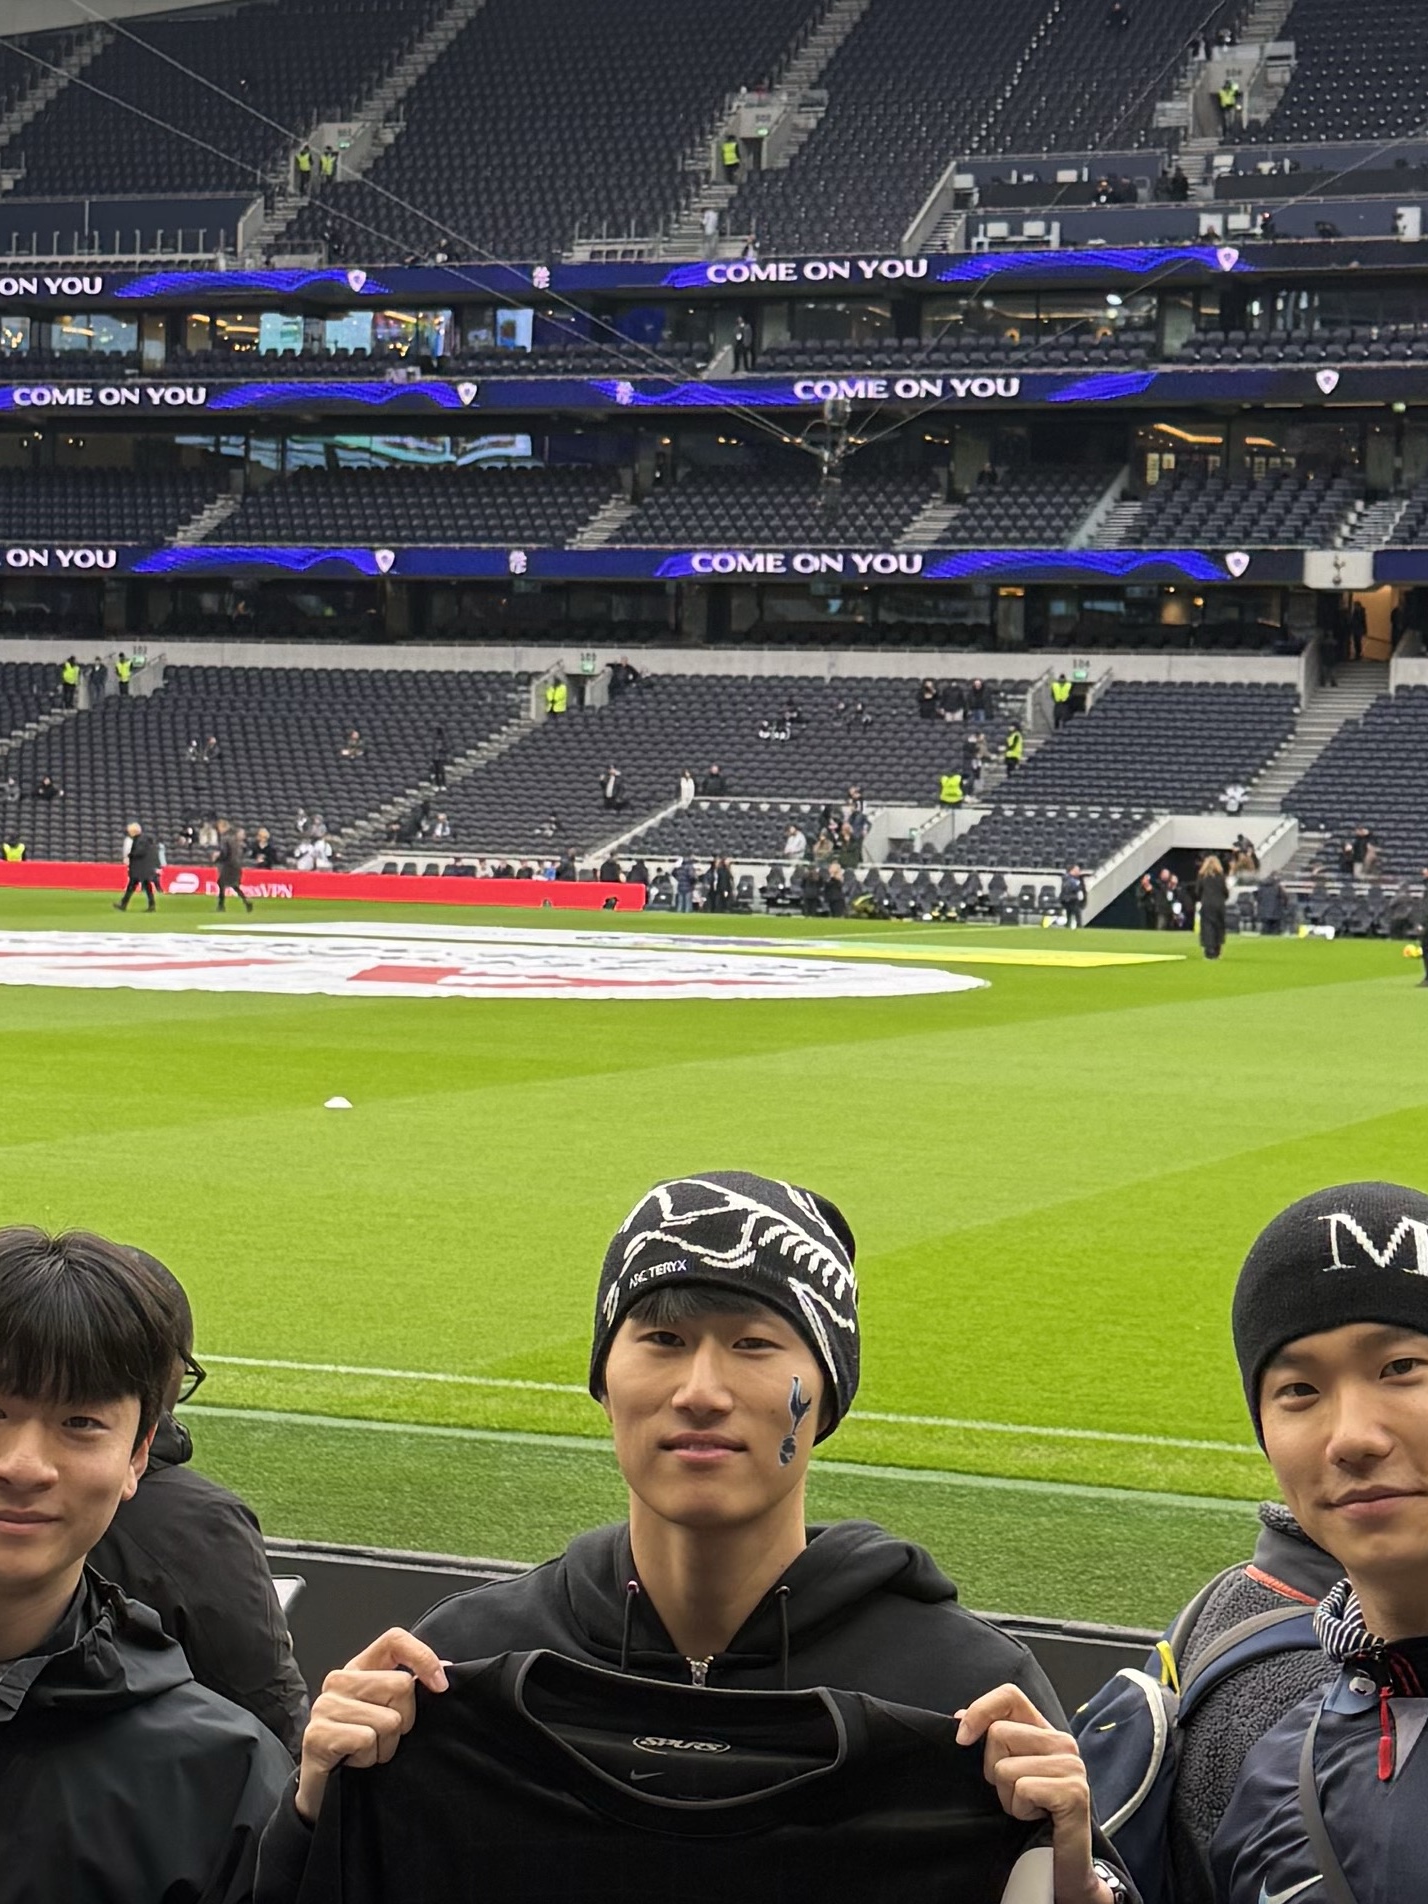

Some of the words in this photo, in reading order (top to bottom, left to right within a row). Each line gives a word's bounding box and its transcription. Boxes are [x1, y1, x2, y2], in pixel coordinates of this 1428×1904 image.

[707, 263, 799, 284] COME
[803, 261, 851, 282] ON
[858, 258, 929, 280] YOU
[44, 276, 103, 296] YOU
[13, 387, 95, 407] COME
[99, 387, 141, 407] ON
[146, 386, 207, 406] YOU
[794, 380, 890, 400] COME
[894, 379, 944, 399] ON
[950, 377, 1021, 398] YOU
[6, 548, 50, 568] ON
[55, 549, 118, 569] YOU
[691, 552, 787, 574] COME
[792, 553, 845, 575] ON
[851, 553, 924, 575] YOU
